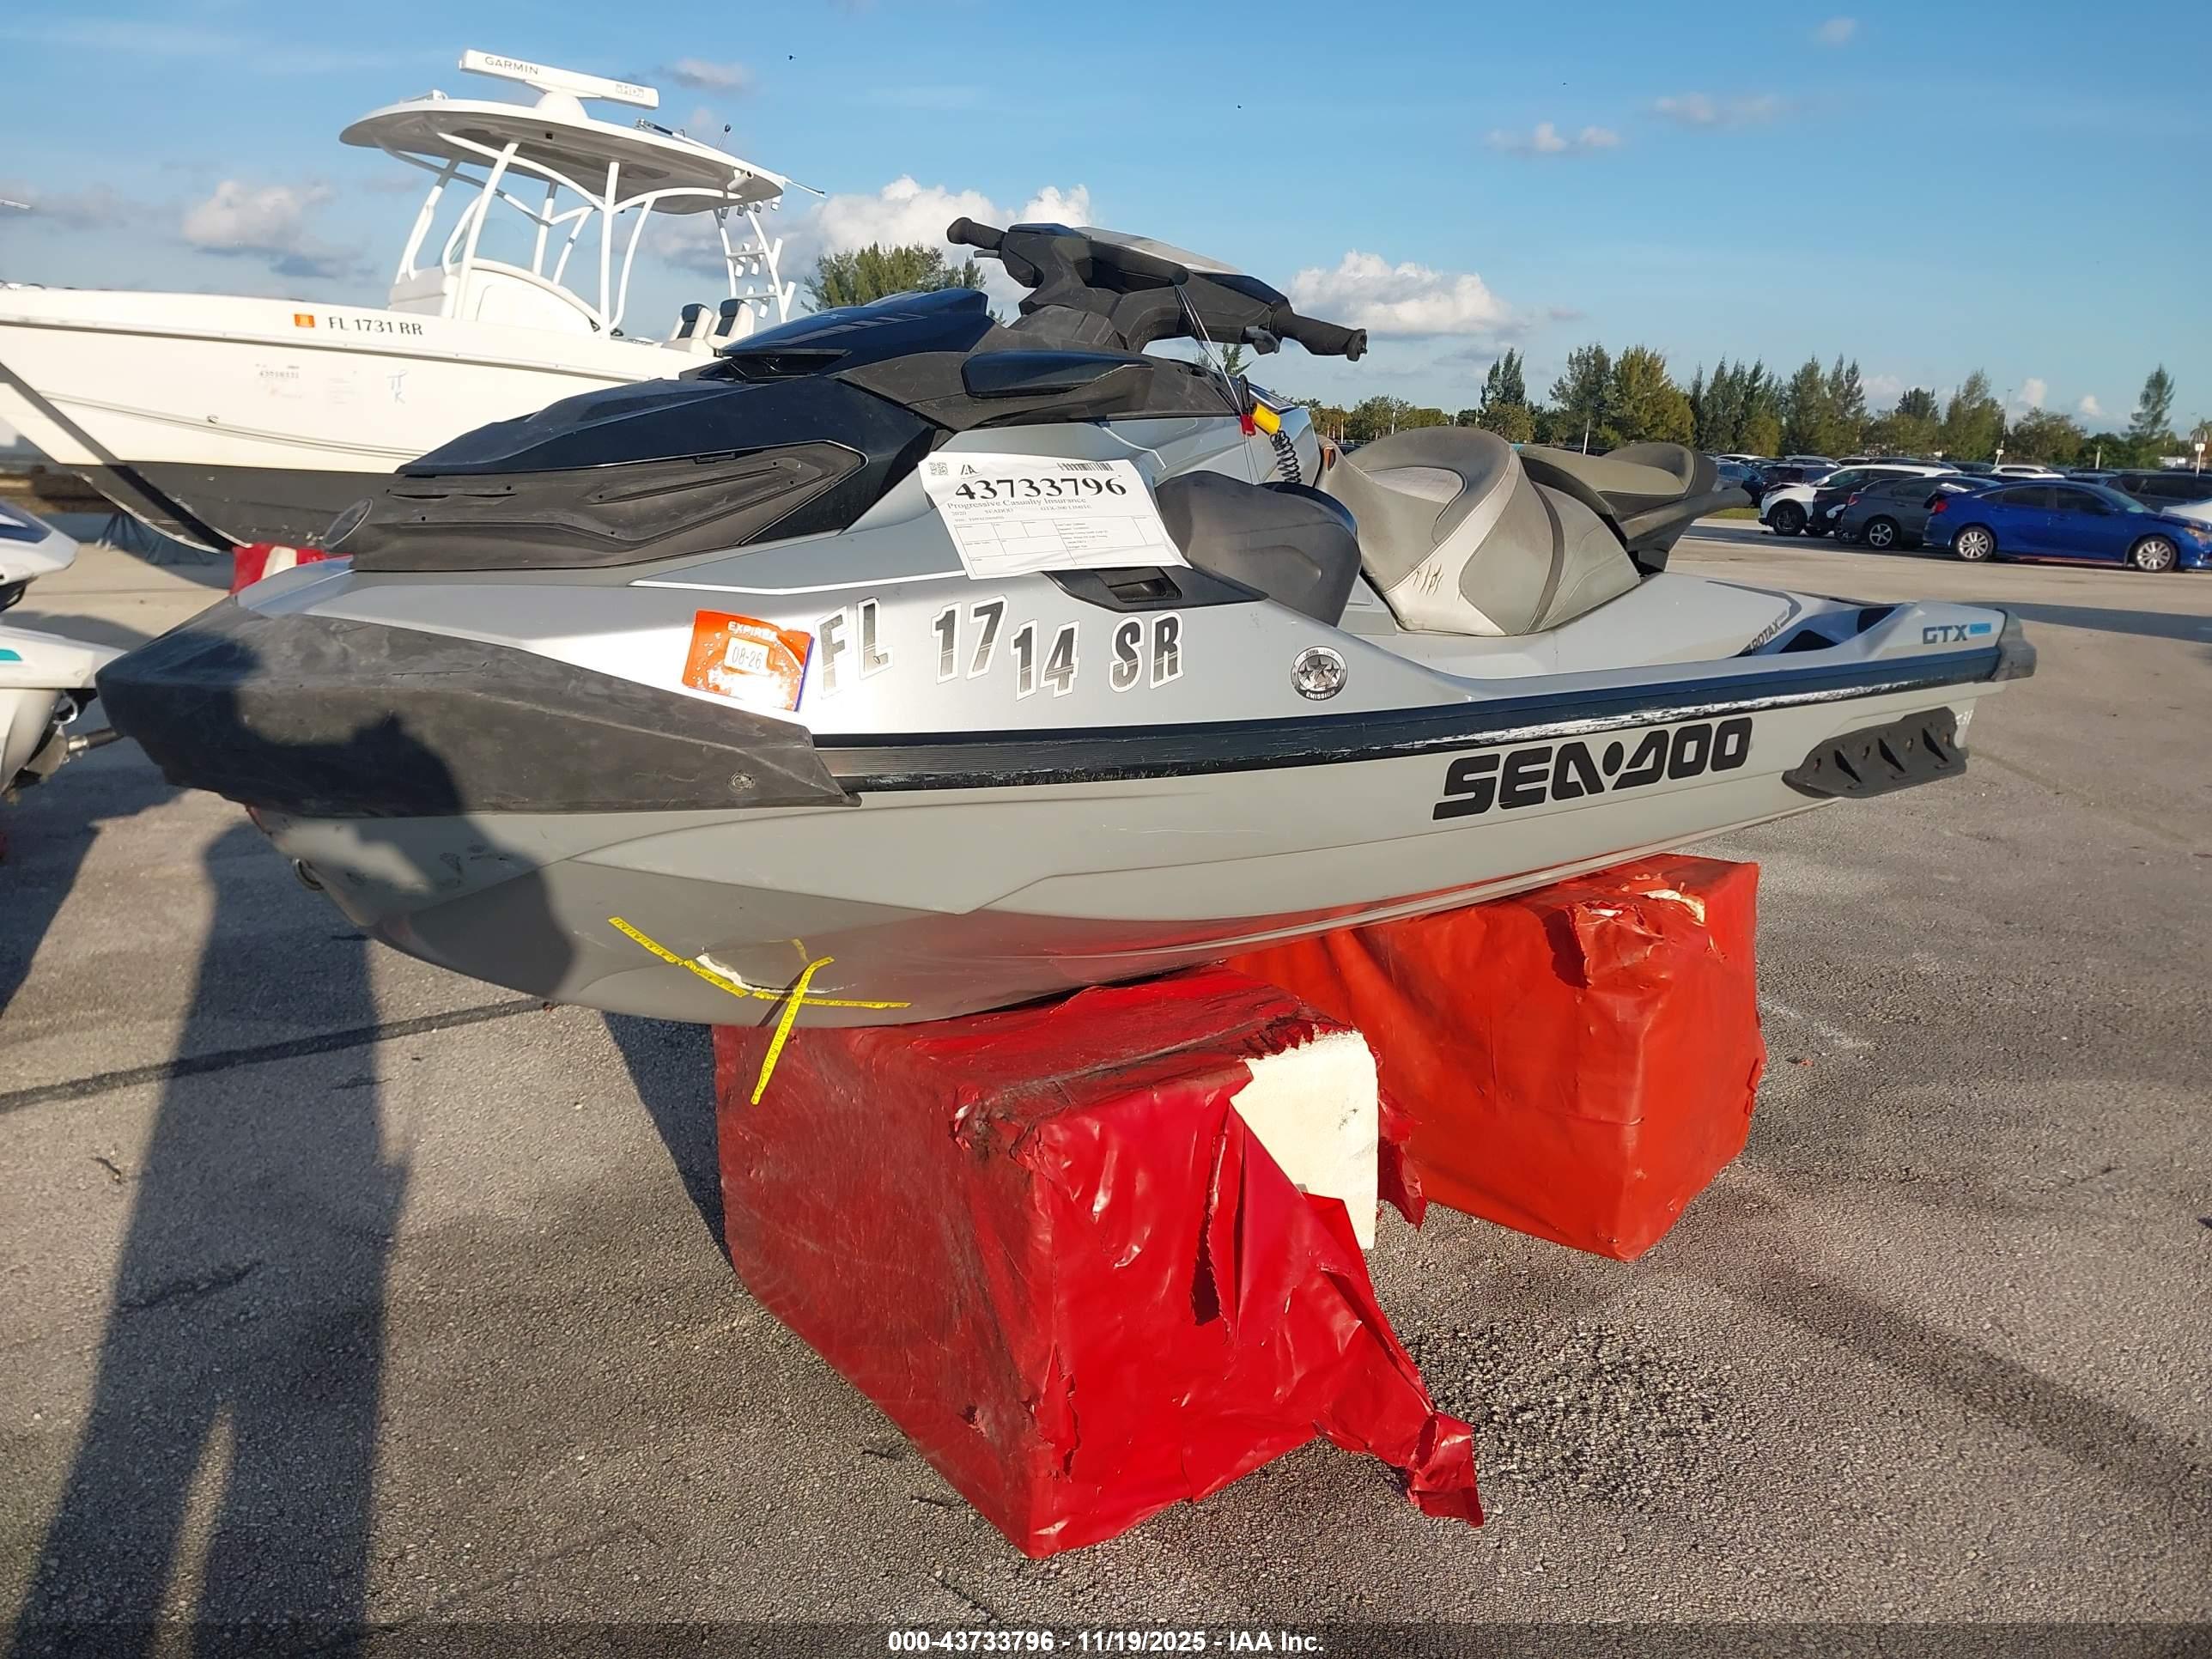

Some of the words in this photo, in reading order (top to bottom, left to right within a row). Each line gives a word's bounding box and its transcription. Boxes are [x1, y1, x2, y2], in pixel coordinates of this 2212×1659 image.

[484, 56, 539, 76] GARMIN
[328, 316, 349, 331] FL
[354, 319, 393, 333] 1731
[399, 322, 423, 336] RR
[954, 477, 1127, 501] 43733796
[947, 501, 1000, 510] Progressive
[1002, 498, 1042, 507] Casualty
[1752, 619, 1781, 652] ROTAX
[1923, 624, 1968, 645] GTX
[732, 645, 763, 670] 08-26
[816, 599, 892, 696] FL
[1109, 612, 1184, 693] SR
[1305, 690, 1336, 700] EMISSION
